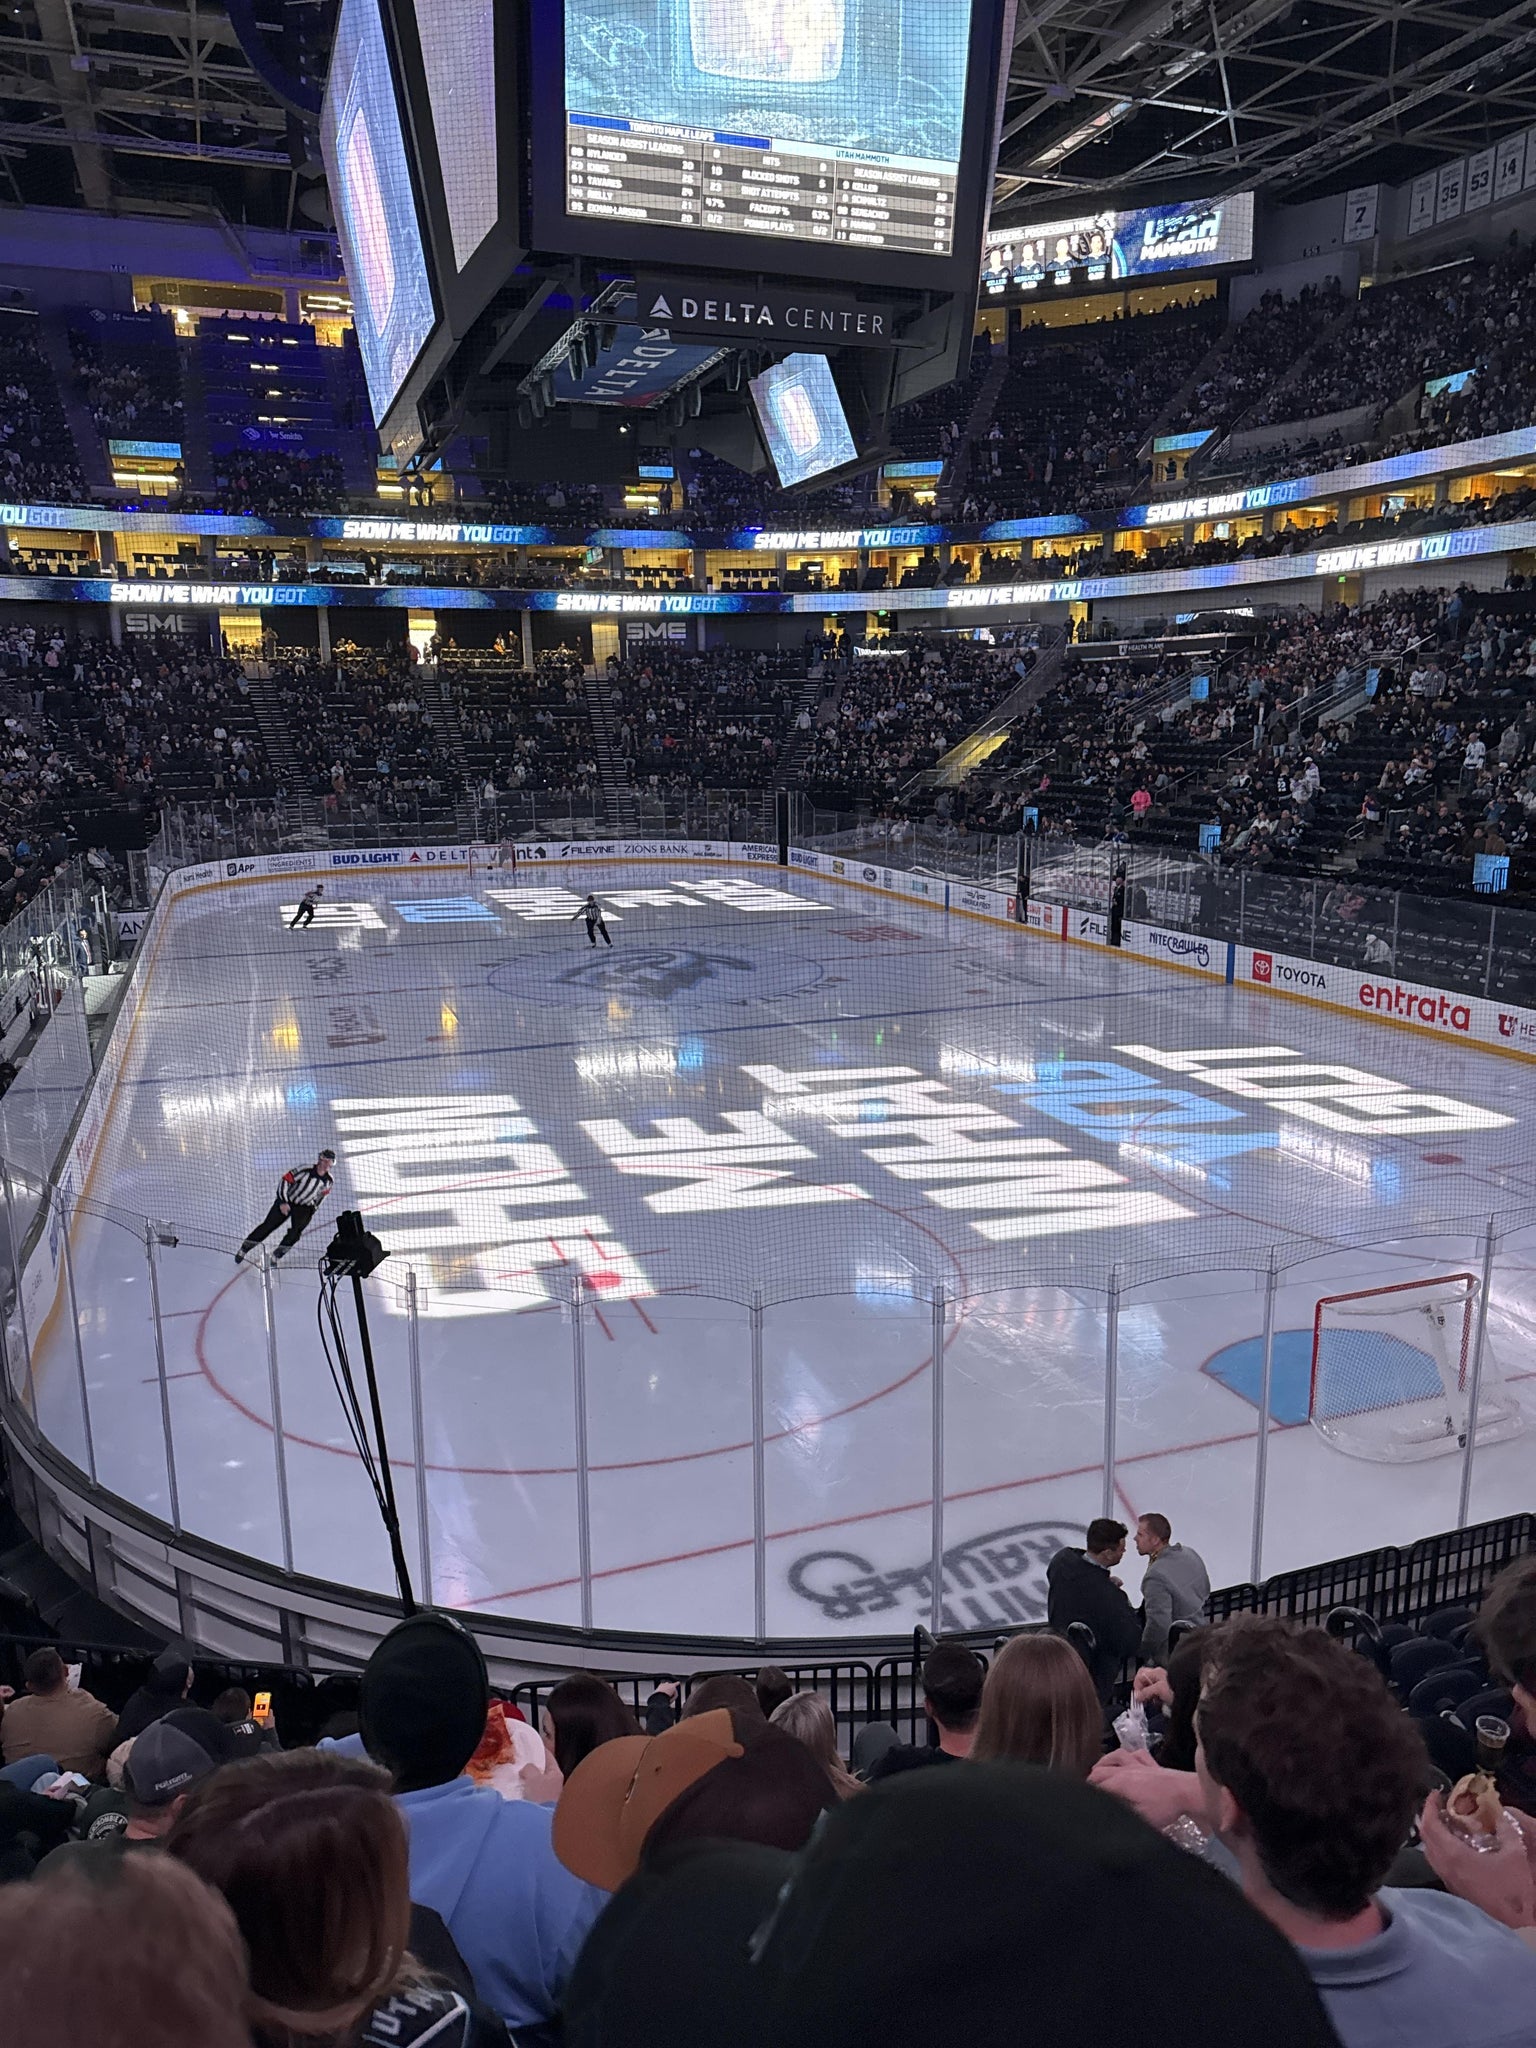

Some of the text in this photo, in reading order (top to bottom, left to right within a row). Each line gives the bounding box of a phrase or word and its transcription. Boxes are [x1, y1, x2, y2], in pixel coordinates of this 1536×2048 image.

[836, 149, 890, 164] UTAH MAMMOTH
[1501, 158, 1516, 179] 14
[1470, 170, 1489, 192] 53
[1441, 182, 1459, 203] 35
[1355, 205, 1367, 224] 7
[1140, 236, 1219, 260] MAMMOTH
[681, 298, 884, 335] DELTA CENTER
[584, 345, 678, 396] DELTA
[1146, 483, 1298, 523] SHOW ME WHAT YOU GOT
[29, 508, 65, 525] GOT
[343, 521, 523, 543] SHOW ME WHAT YOU GOT
[754, 528, 920, 549] SHOW ME WHAT YOU GOT
[1315, 532, 1484, 574] SHOW ME WHAT YOU GOT
[111, 583, 306, 604] SHOW ME WHAT YOU GOT
[556, 593, 720, 612] SHOW ME WHAT YOU GOT
[947, 581, 1109, 607] SHOW ME WHAT YOU GOT
[125, 613, 198, 633] SME
[626, 622, 687, 640] SME
[1128, 643, 1148, 651] HEALTH
[332, 852, 400, 865] BUD LIGHT
[426, 850, 479, 861] DELTA
[571, 845, 615, 854] FILEVINE
[624, 843, 688, 854] ZIONS BANK
[742, 844, 777, 853] AMERICAN
[747, 852, 778, 861] EXPRESS
[269, 859, 312, 868] INGREDIENTS
[790, 852, 818, 867] BUD LIGHT
[1089, 922, 1132, 943] FILENE
[1150, 931, 1210, 967] NITECRAWLER
[1276, 965, 1327, 990] TOYOTA
[1359, 983, 1471, 1031] entrata
[1111, 1044, 1518, 1135] GOT
[577, 1110, 872, 1213] ME
[738, 1065, 1201, 1240] WHAT
[330, 1095, 657, 1318] SHOW
